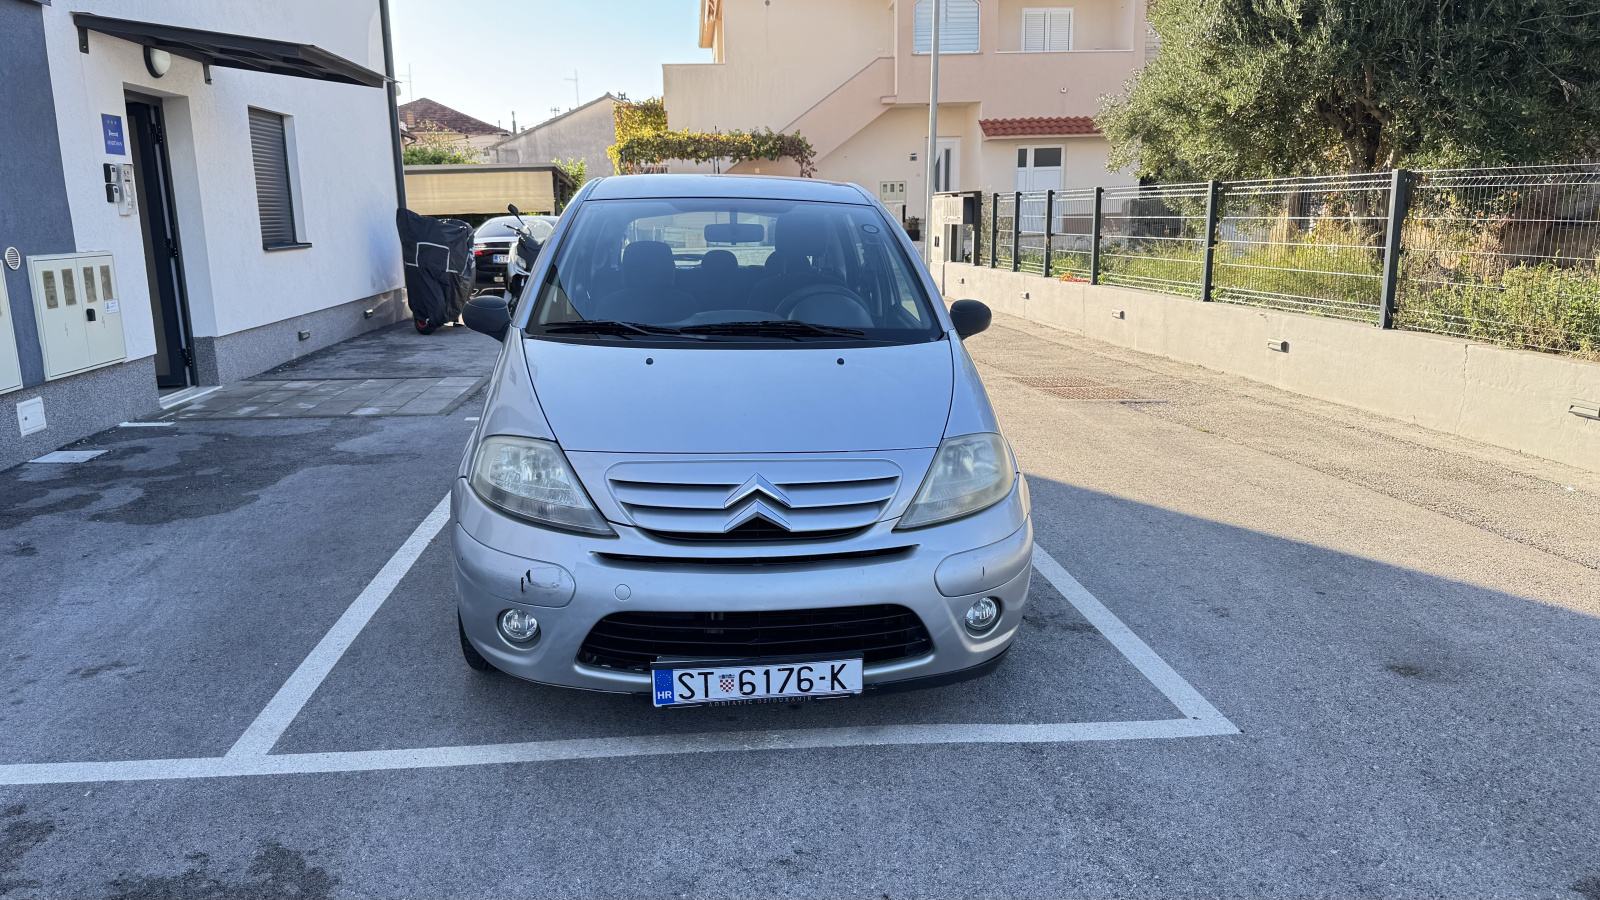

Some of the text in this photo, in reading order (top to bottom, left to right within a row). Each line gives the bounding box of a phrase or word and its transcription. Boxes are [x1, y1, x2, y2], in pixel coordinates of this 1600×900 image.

[678, 663, 847, 700] ST 6176-K
[657, 690, 672, 700] HR
[708, 699, 753, 707] ADRIATIC
